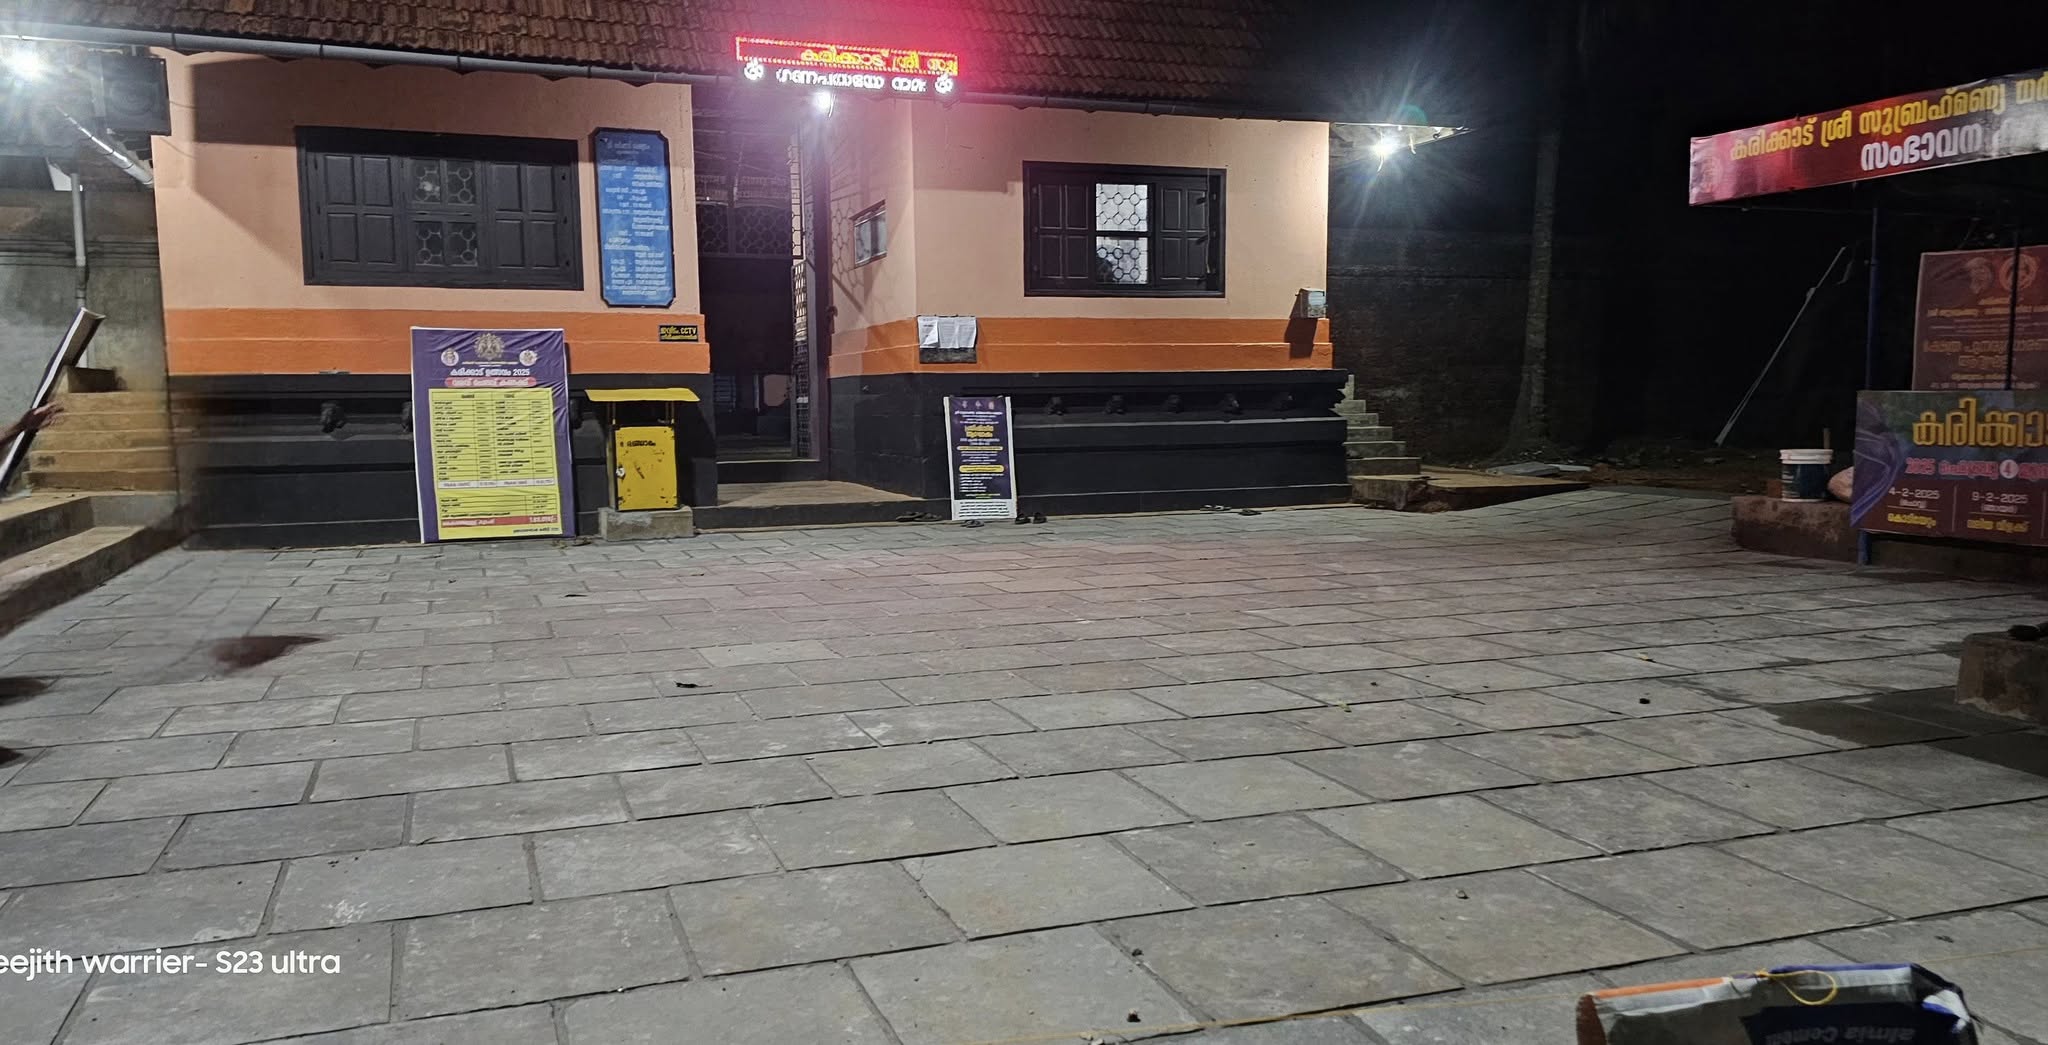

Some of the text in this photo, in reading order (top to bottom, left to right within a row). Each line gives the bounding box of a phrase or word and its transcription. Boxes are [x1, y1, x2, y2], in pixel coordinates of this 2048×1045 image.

[1730, 117, 1817, 161] കരിക്കാട്
[1821, 110, 1853, 148] ശ്രീ
[1860, 122, 1983, 171] സംഭാവന
[680, 327, 697, 335] CCTV
[512, 368, 531, 376] 2025
[1912, 394, 2048, 448] കരിക്കാ
[1904, 457, 1935, 475] 2025
[1888, 486, 1941, 500] 4-2-2025
[1971, 491, 2029, 505] 9-2-2025
